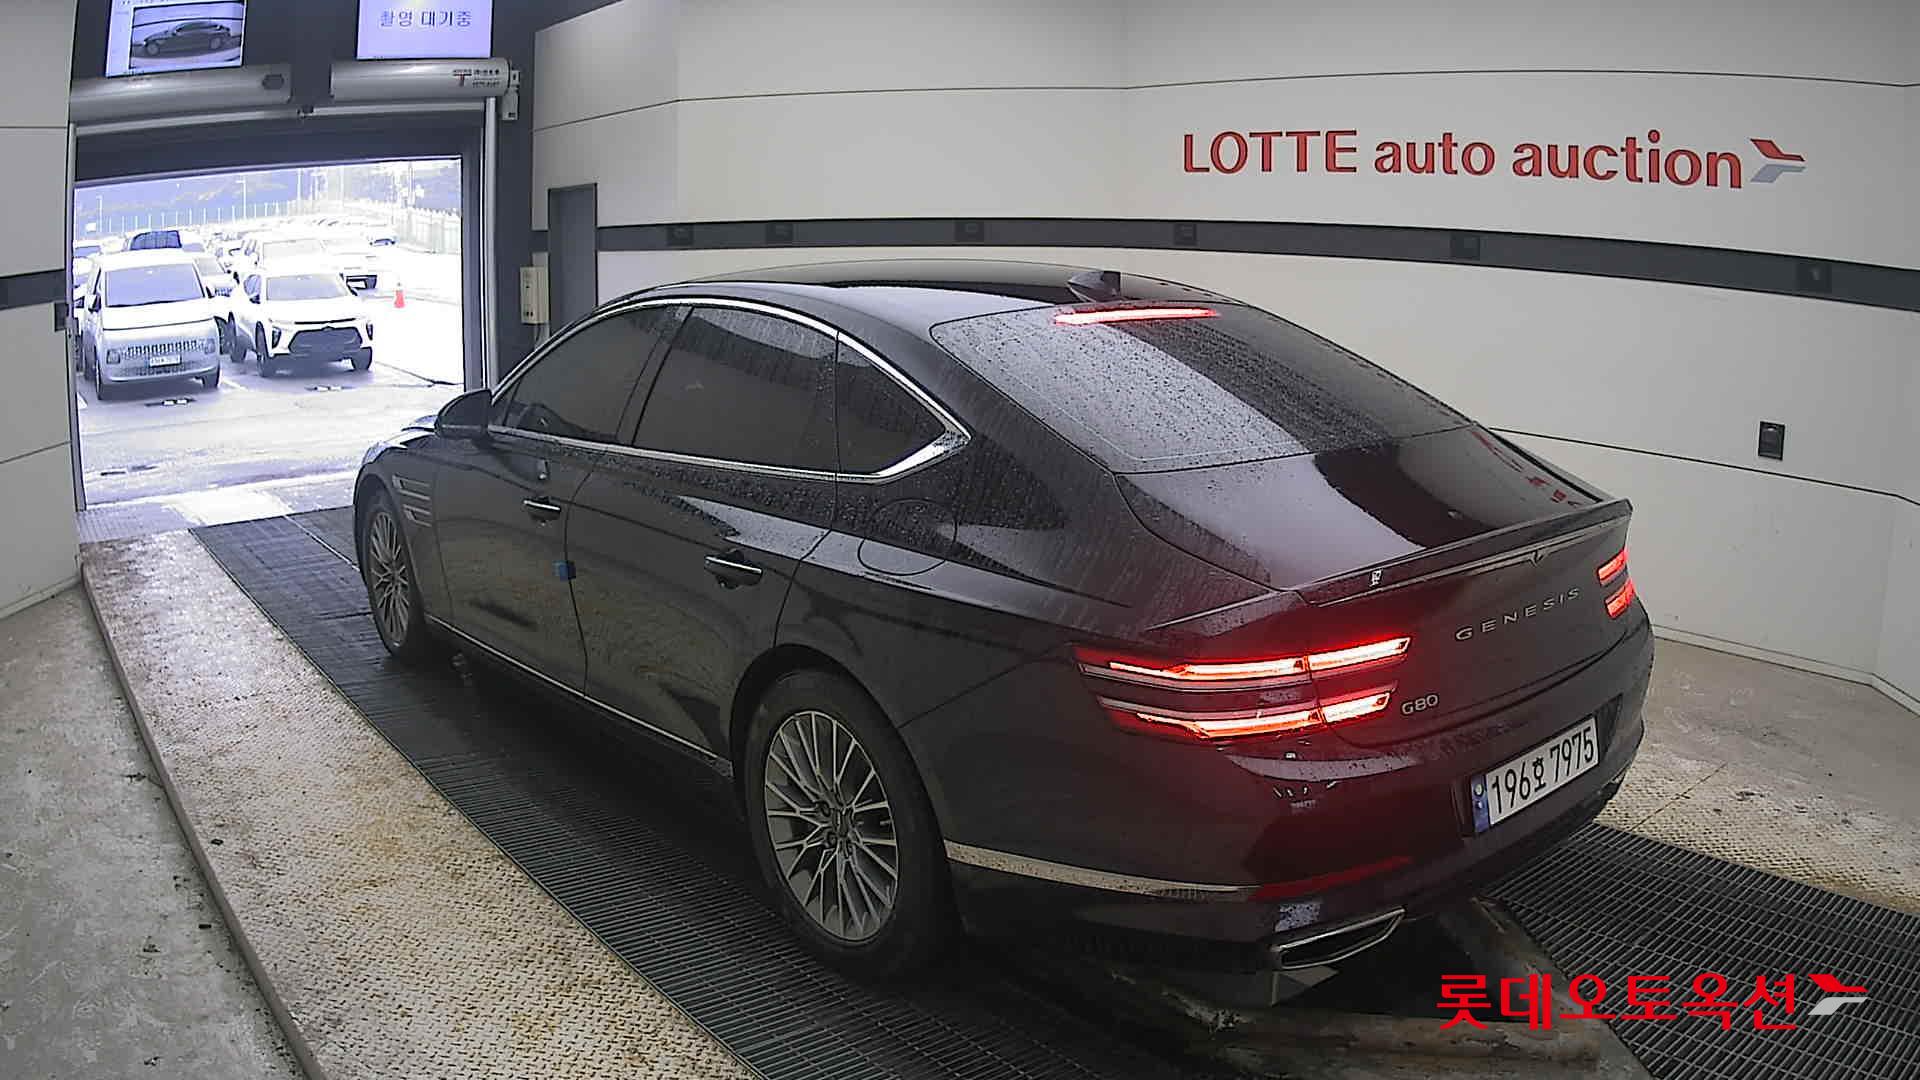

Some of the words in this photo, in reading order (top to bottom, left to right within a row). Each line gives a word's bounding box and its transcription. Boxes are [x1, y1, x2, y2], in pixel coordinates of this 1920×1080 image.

[421, 10, 472, 27] 대기중
[1183, 130, 1357, 174] LOTTE
[1375, 132, 1496, 176] auto
[1512, 130, 1743, 189] auction
[1455, 587, 1580, 641] GENESIS
[1401, 694, 1440, 716] G80
